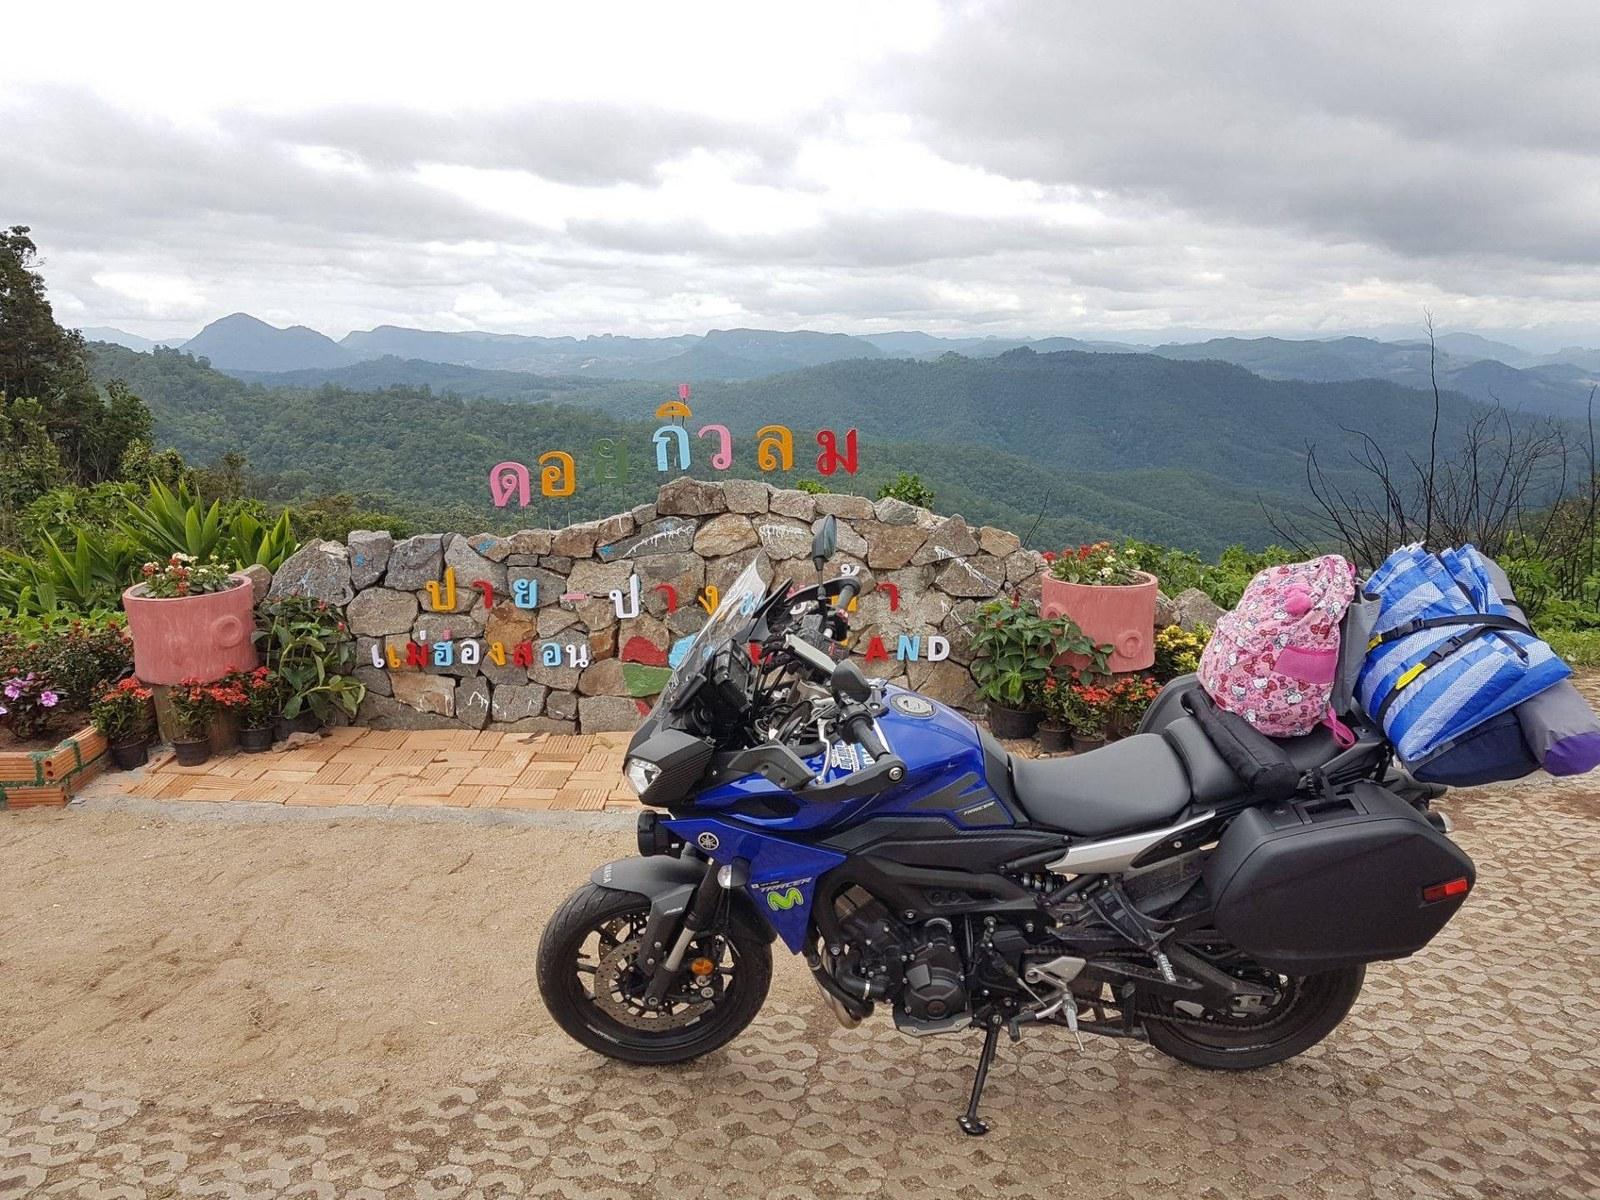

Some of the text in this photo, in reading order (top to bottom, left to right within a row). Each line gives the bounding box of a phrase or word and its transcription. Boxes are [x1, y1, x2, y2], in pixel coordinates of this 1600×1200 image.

[425, 565, 538, 612] ปาย
[371, 627, 590, 669] แม่ฮ่องสอน
